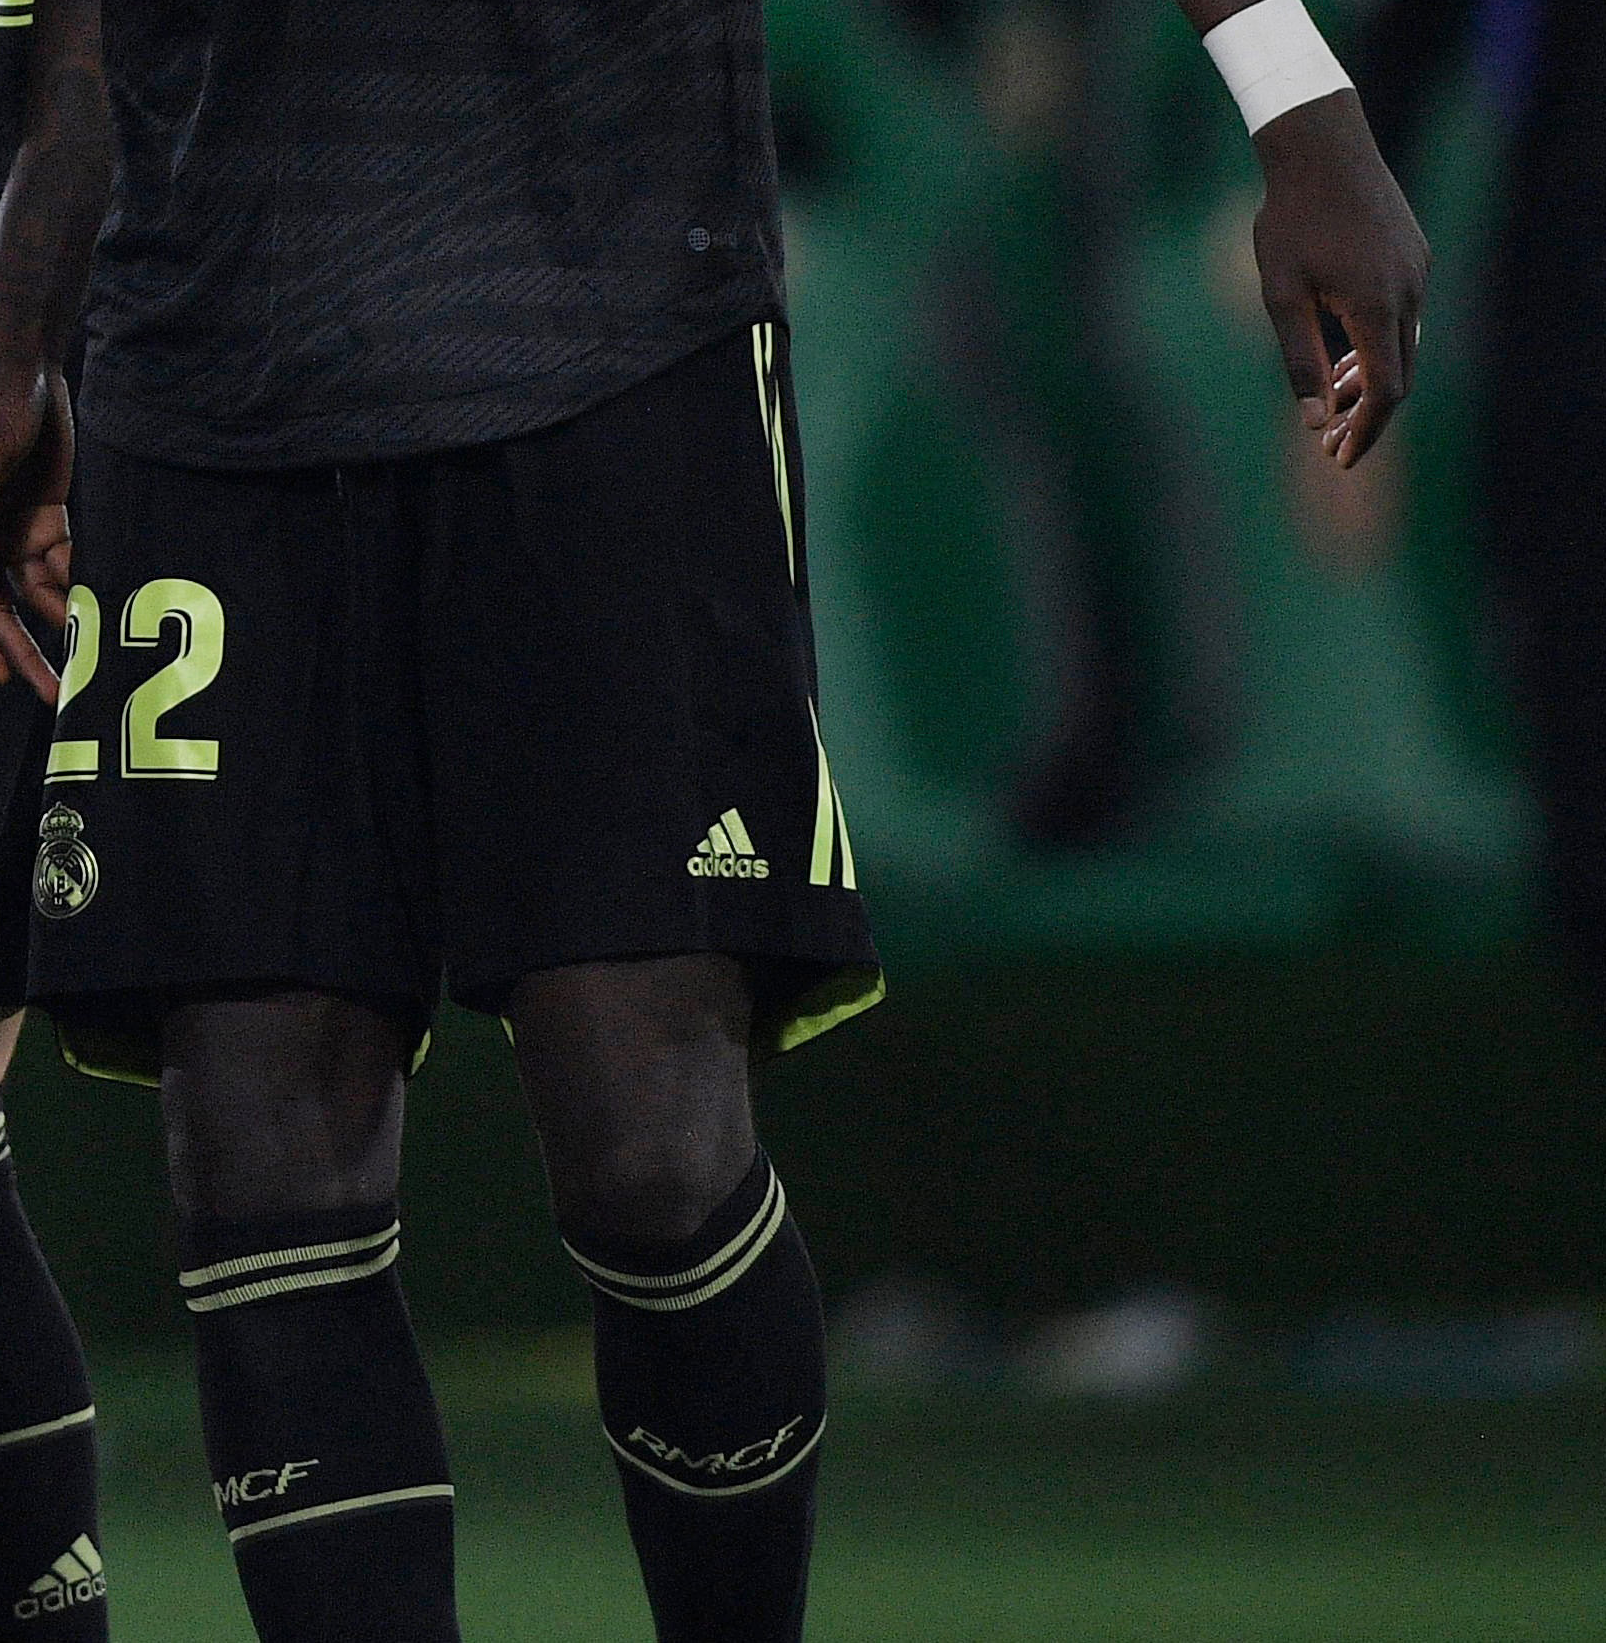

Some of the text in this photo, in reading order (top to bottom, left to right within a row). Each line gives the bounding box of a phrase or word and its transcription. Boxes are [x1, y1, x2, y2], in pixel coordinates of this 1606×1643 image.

[43, 578, 226, 782] 22
[686, 851, 770, 879] adidas
[627, 1415, 804, 1475] RMCF
[213, 1458, 320, 1512] MCF
[14, 1572, 108, 1620] adida
